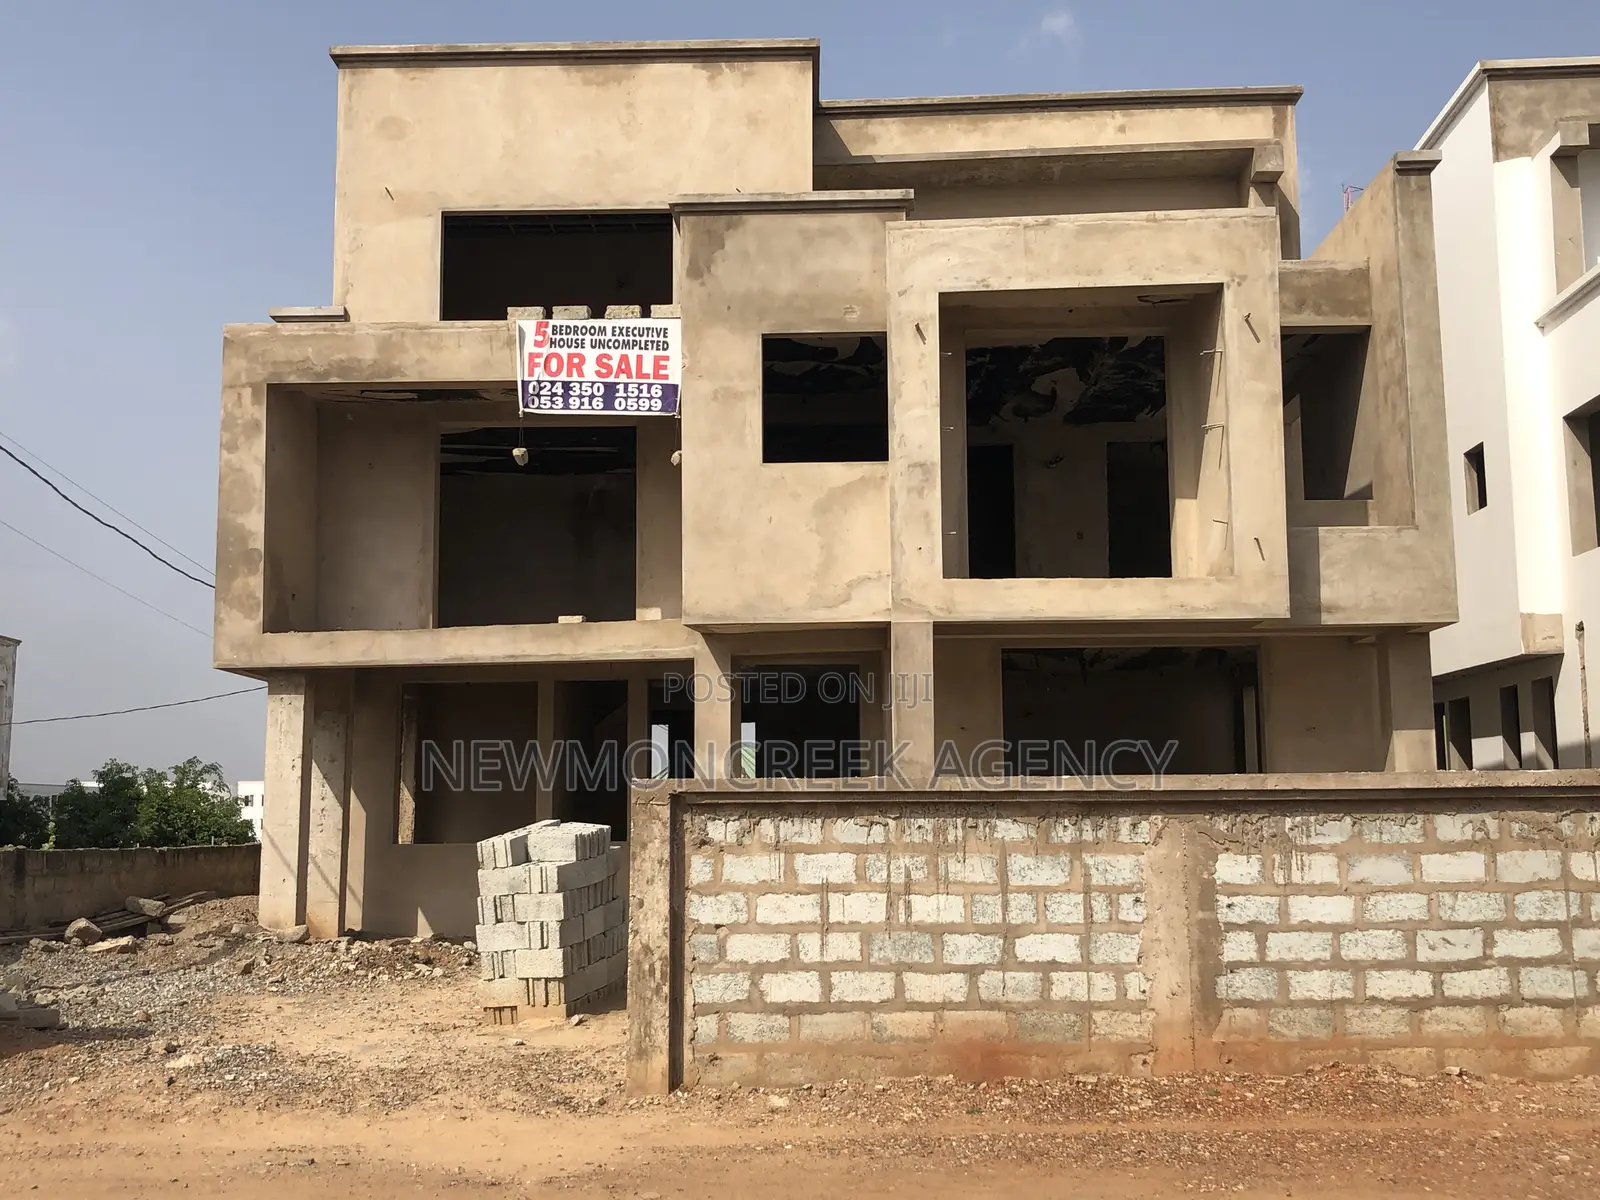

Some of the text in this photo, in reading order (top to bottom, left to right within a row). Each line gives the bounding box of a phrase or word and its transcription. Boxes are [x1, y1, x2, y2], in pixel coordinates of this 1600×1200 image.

[534, 321, 668, 348] 5 BEDROOM EXECUTIVE
[550, 338, 669, 351] HOUSE UNCOMPLETED
[528, 352, 670, 380] FOR SALE
[528, 382, 662, 397] 024 350 1516
[528, 396, 662, 411] 053 916 0599
